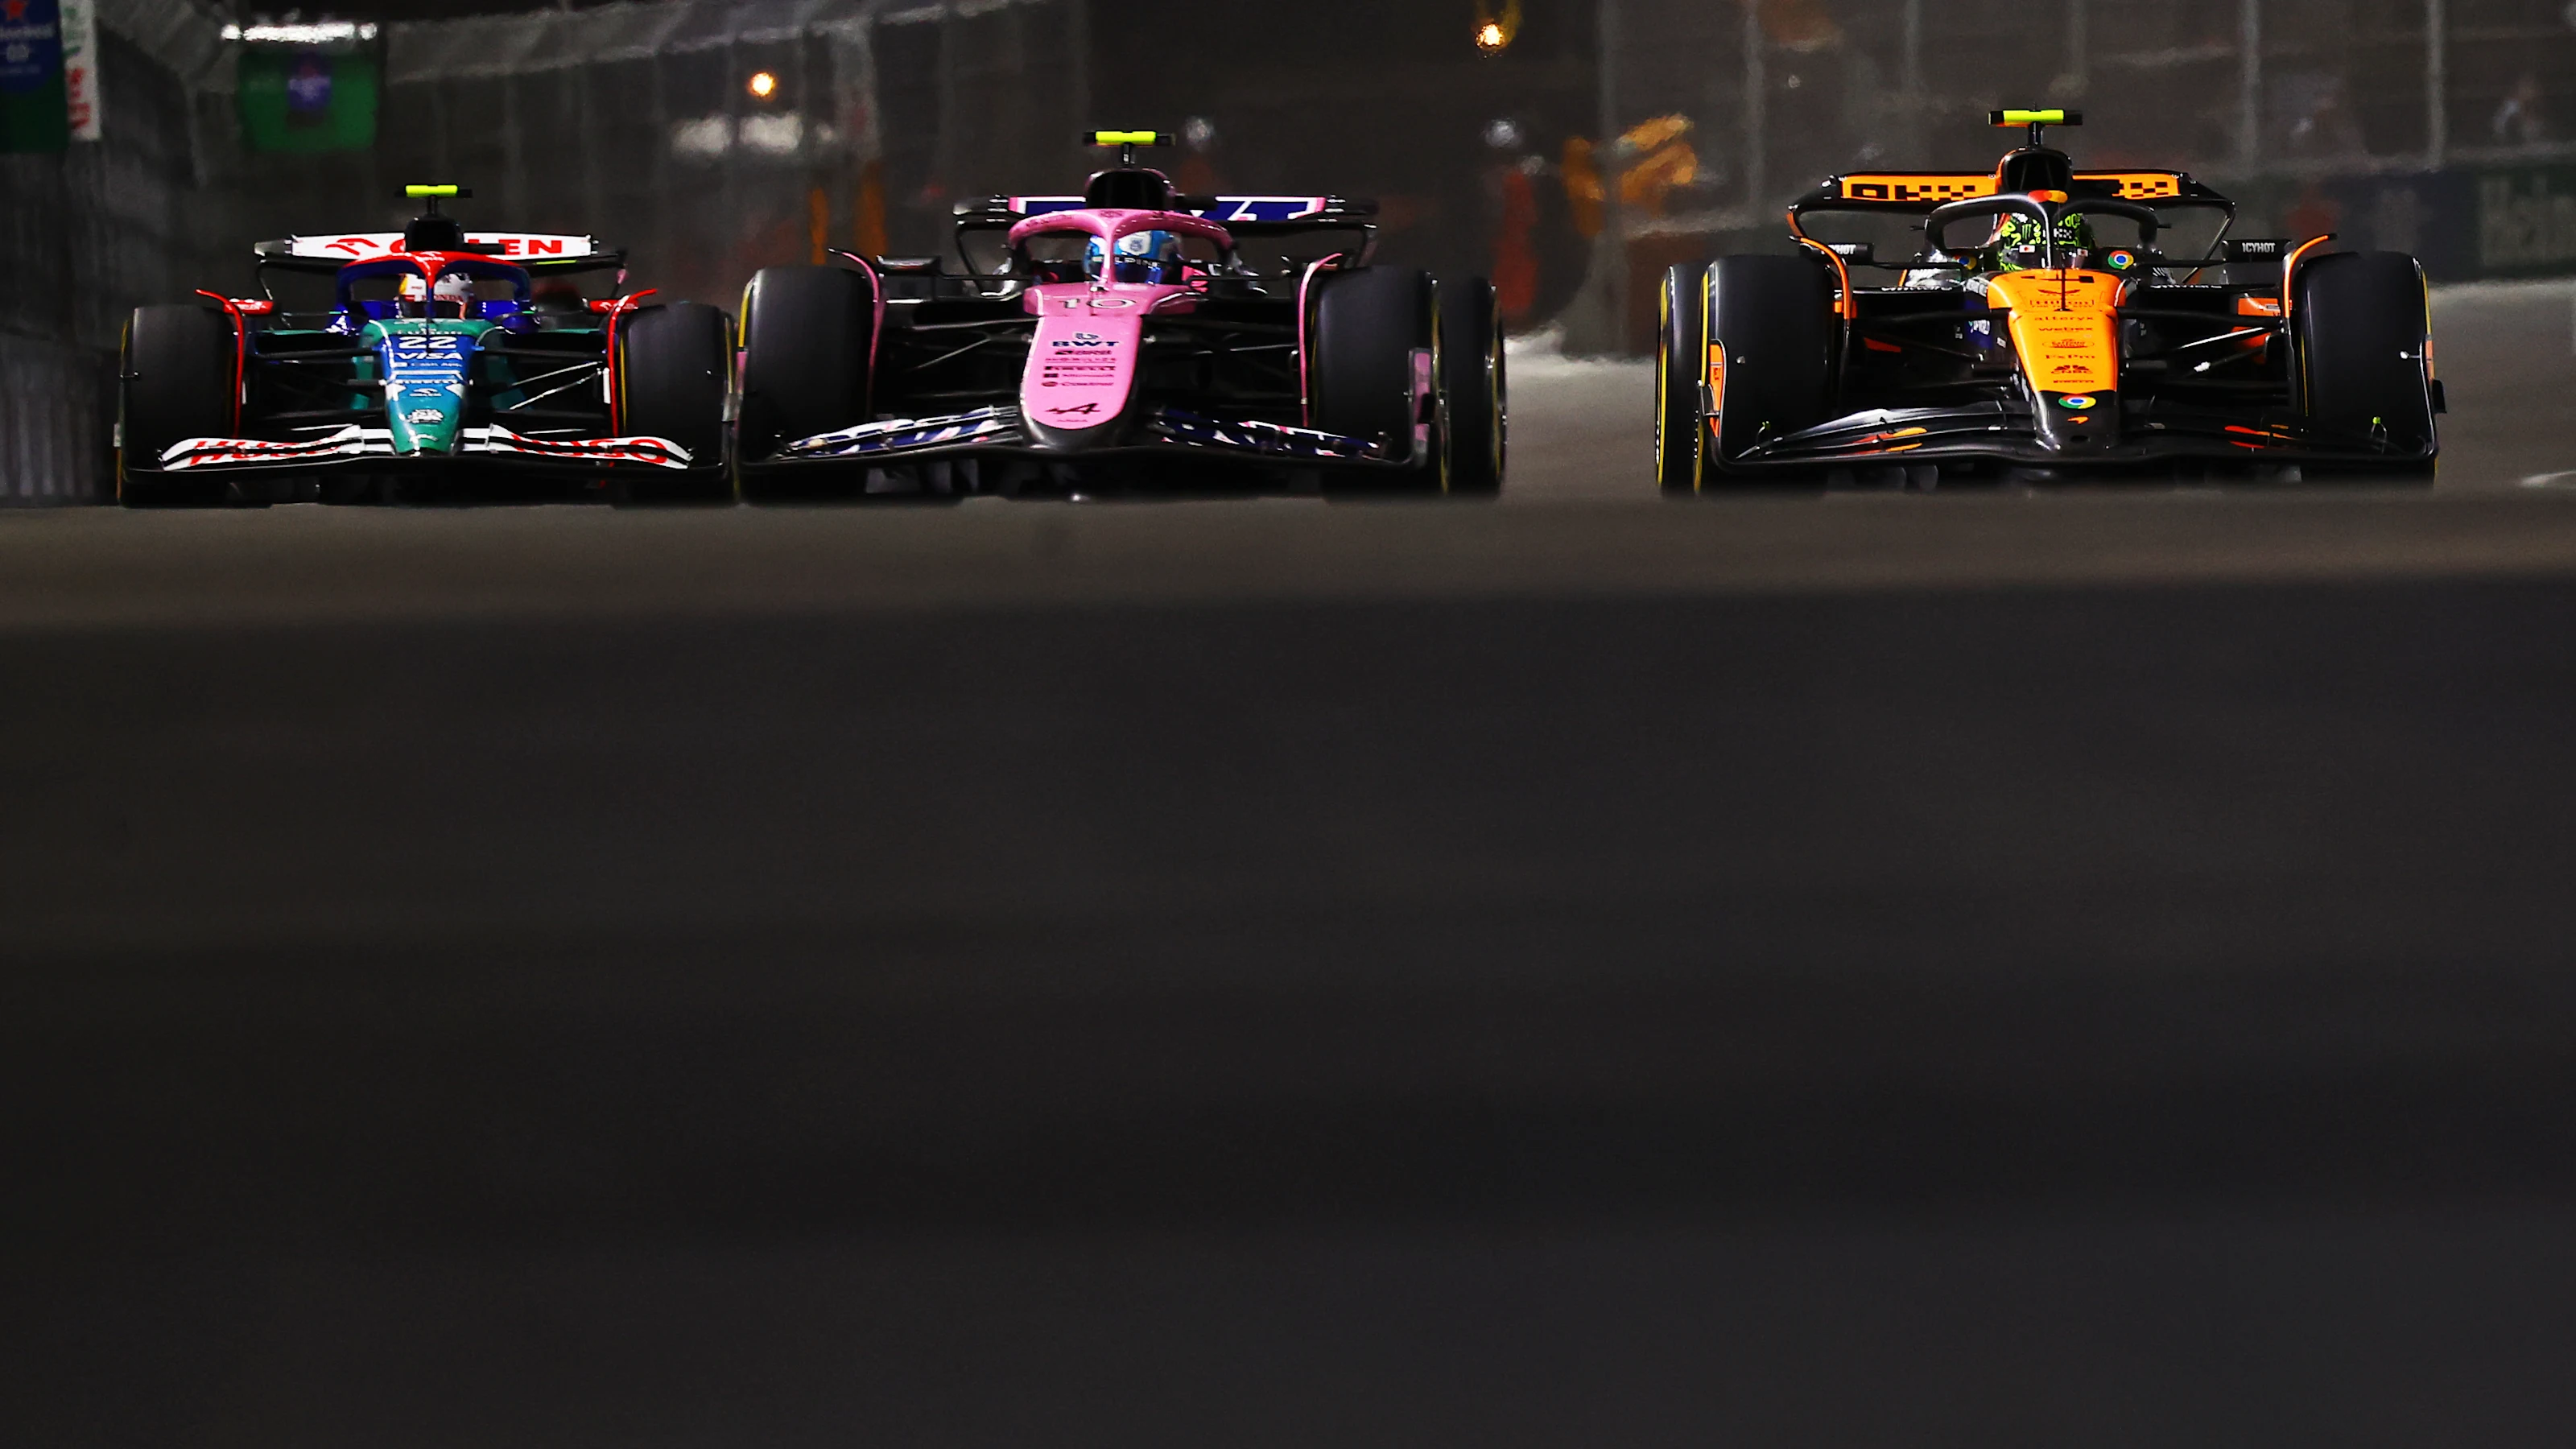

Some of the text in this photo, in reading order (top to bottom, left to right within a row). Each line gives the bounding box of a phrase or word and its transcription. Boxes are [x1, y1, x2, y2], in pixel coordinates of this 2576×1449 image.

[2241, 242, 2276, 253] ICYHOT
[1059, 298, 1137, 309] 10
[398, 336, 457, 349] 22
[1052, 341, 1119, 349] BWT
